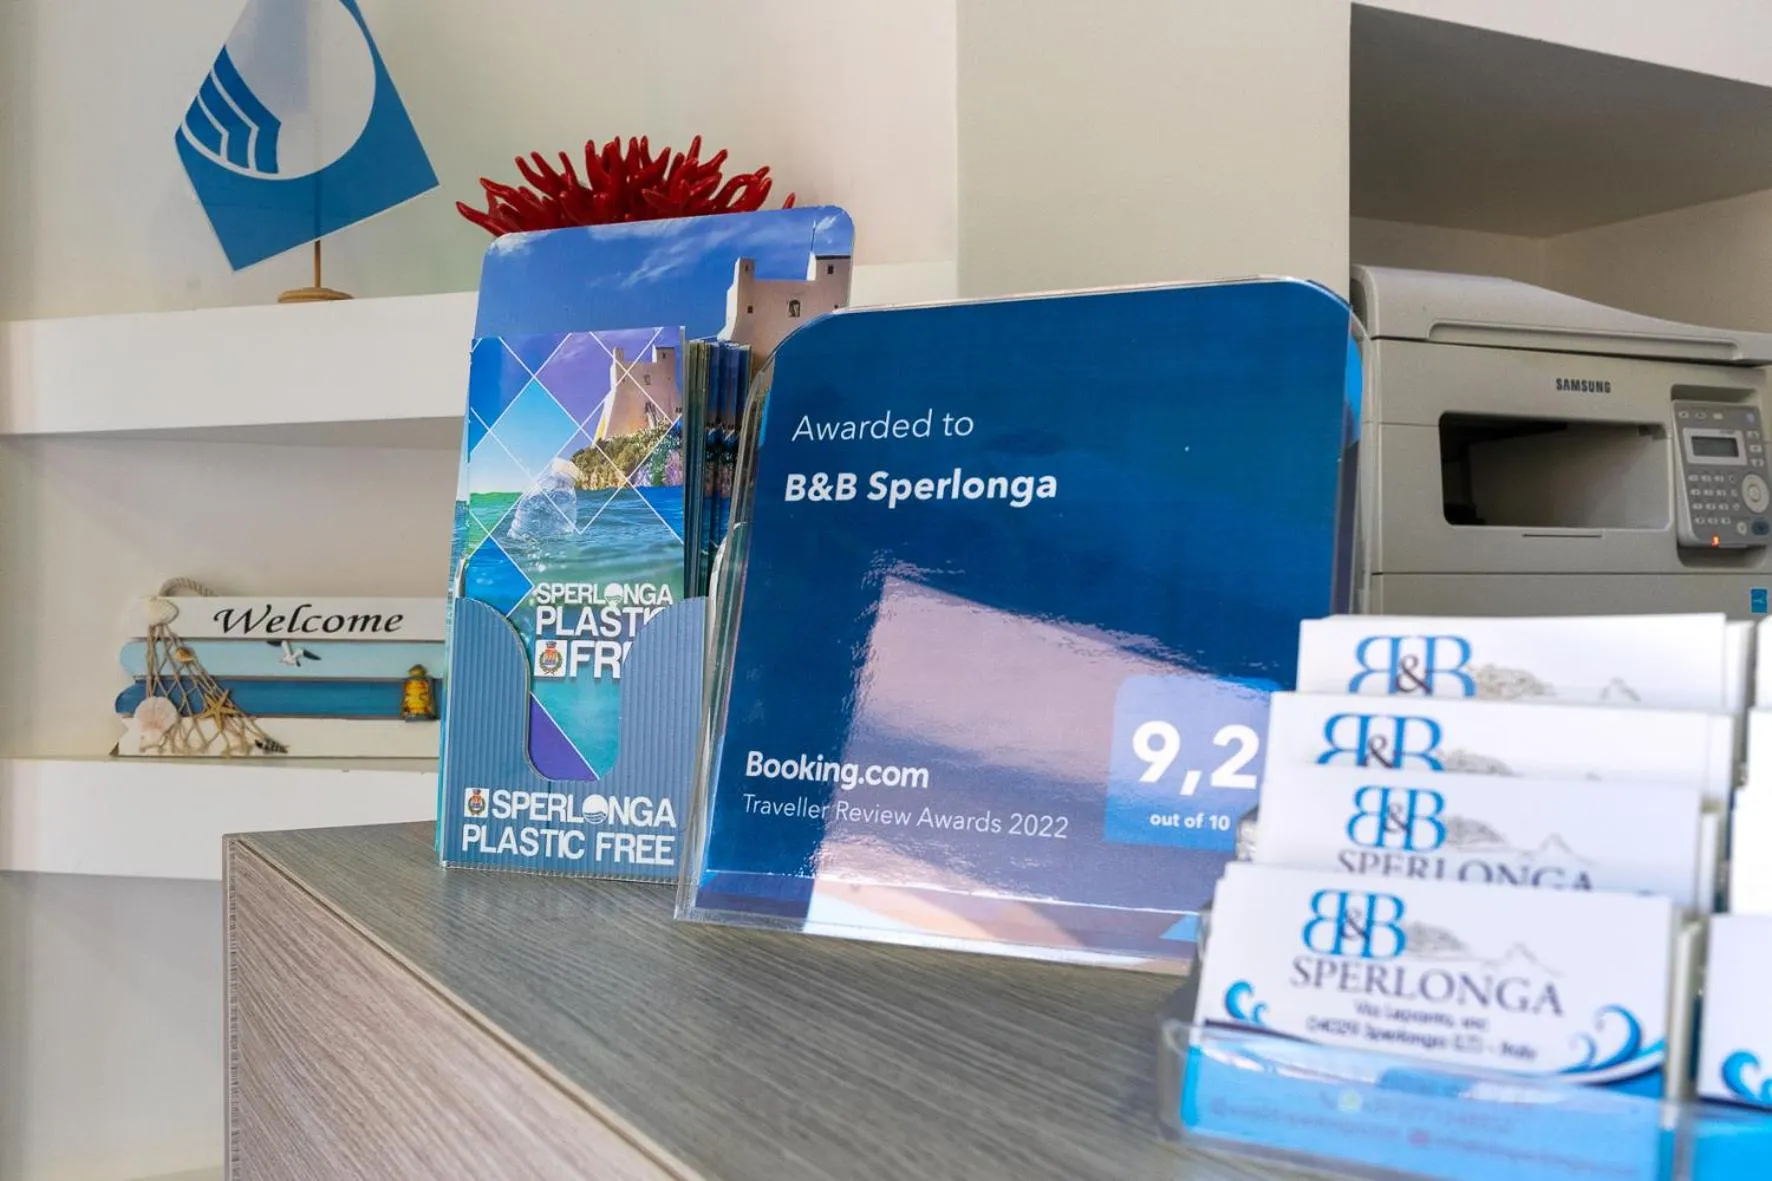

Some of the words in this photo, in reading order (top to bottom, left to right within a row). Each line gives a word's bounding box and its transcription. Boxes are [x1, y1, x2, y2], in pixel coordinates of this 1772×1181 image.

[1555, 378, 1611, 394] SAMSUNG
[791, 408, 933, 442] Awarded
[942, 412, 974, 437] to
[785, 472, 858, 502] B&B
[867, 467, 1057, 509] Sperlonga
[213, 604, 404, 634] Welcome
[535, 604, 666, 638] PLASTI
[569, 640, 633, 679] FR
[744, 750, 929, 790] Booking.com
[1130, 719, 1260, 797] 9,2
[742, 794, 829, 820] Traveller
[835, 801, 911, 827] Review
[916, 807, 1001, 834] Awards
[1008, 812, 1069, 839] 2022
[1149, 813, 1179, 828] out
[1184, 813, 1204, 829] of
[1209, 815, 1231, 831] 10
[462, 824, 585, 860] PLASTIC
[595, 832, 676, 866] FREE
[1289, 955, 1567, 1018] SPERLONGA
